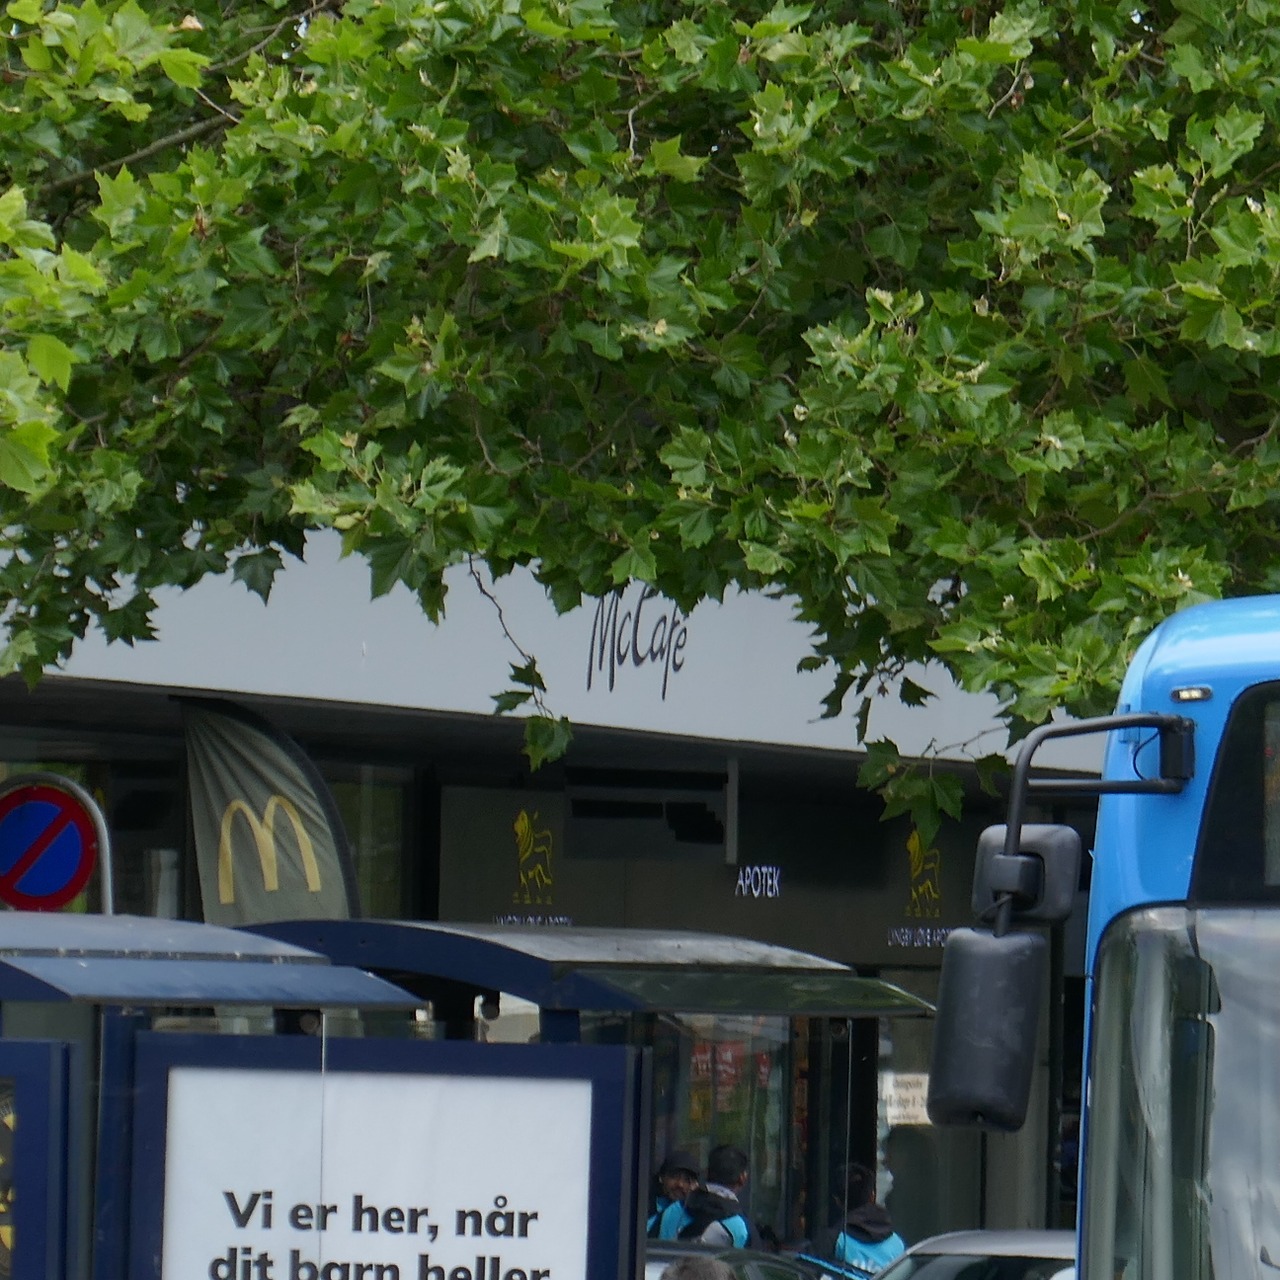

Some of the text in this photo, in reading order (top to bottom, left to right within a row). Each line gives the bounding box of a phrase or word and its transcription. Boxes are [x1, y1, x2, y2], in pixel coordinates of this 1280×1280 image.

[735, 866, 780, 898] APOTEK
[223, 1190, 539, 1243] Vi er her, når
